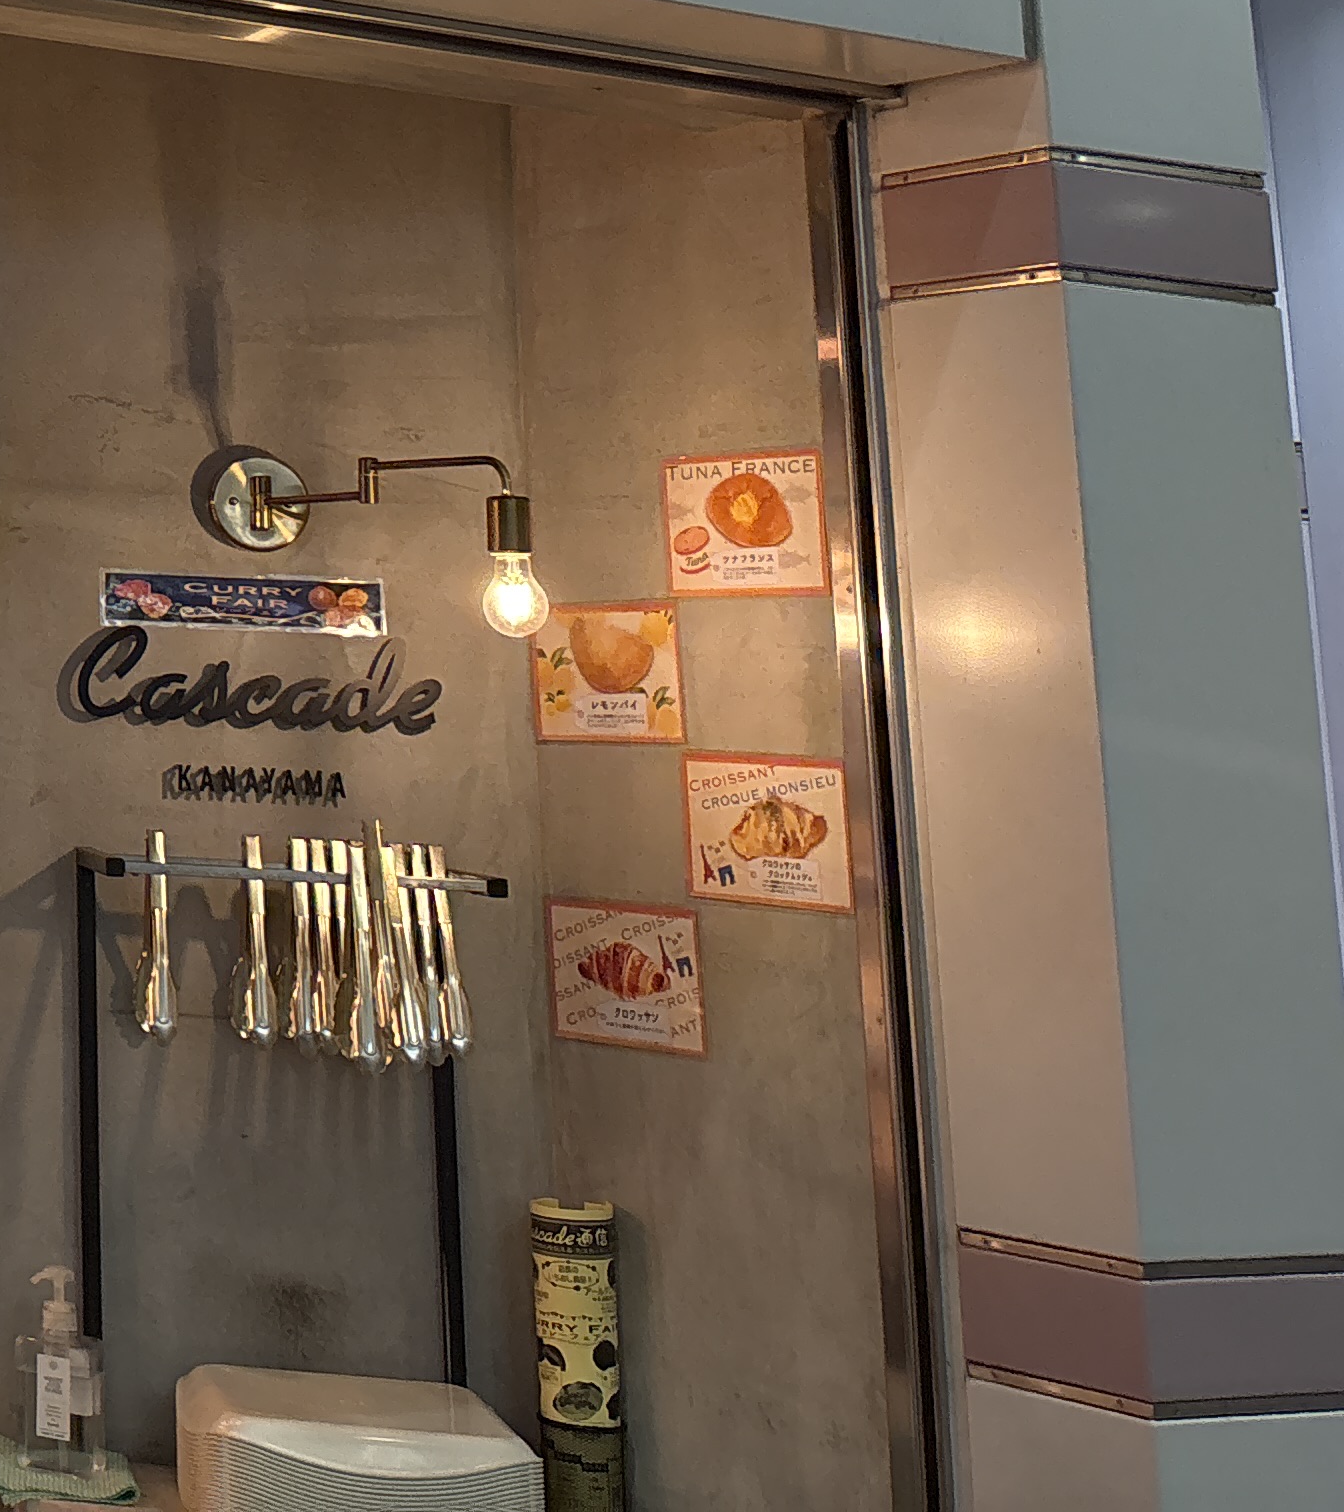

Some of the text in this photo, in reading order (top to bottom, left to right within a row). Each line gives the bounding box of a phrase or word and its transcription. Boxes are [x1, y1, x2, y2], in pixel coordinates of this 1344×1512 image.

[666, 459, 816, 482] TUNA FRANCE
[684, 551, 710, 567] Tuna
[183, 582, 303, 597] CURRY
[211, 595, 289, 609] FAIR
[77, 625, 443, 736] Cascade
[176, 763, 346, 801] KANAYAMA
[689, 765, 777, 792] CROISSANT
[701, 788, 760, 811] CROQUE
[536, 1319, 578, 1333] RRY
